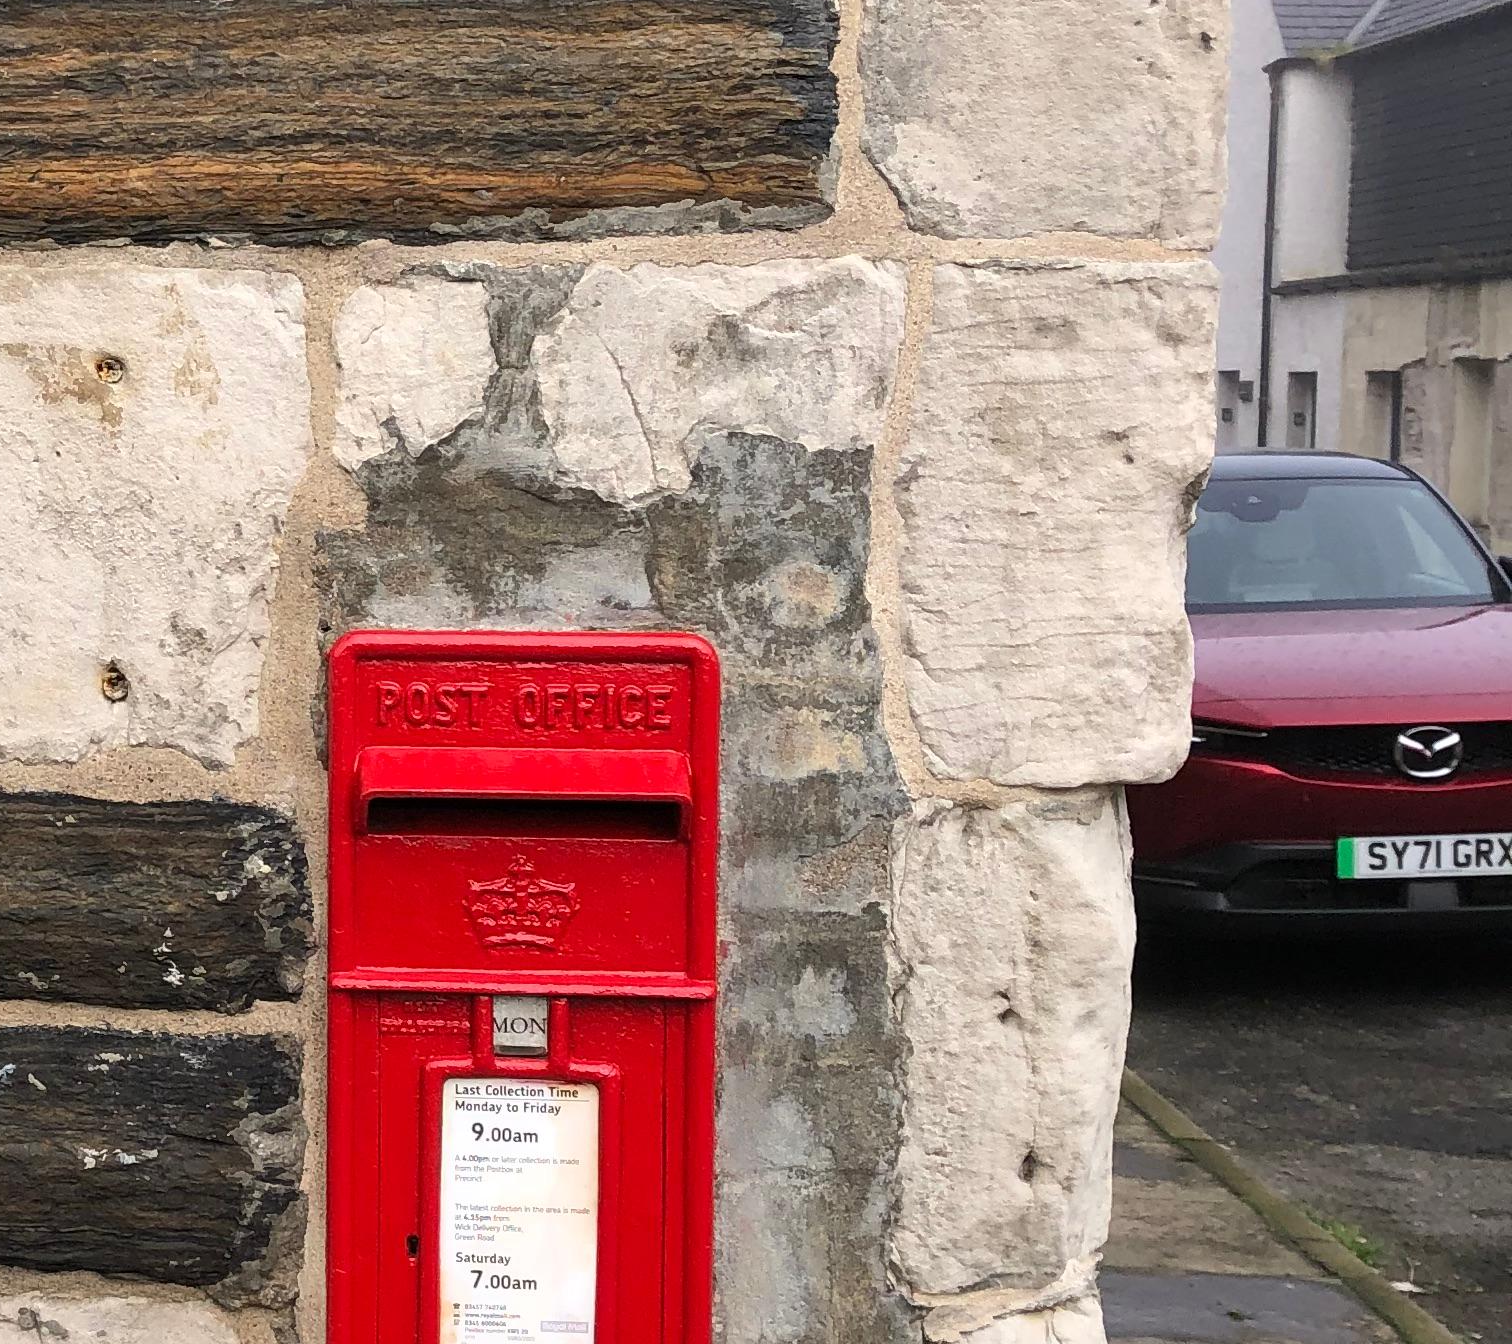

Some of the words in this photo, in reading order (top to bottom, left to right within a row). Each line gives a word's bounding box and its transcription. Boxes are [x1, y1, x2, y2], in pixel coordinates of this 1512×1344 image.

[376, 680, 495, 729] POST
[514, 683, 674, 731] OFFICE
[1368, 840, 1442, 871] SY71
[1452, 838, 1512, 869] GRX
[493, 1017, 547, 1034] MON
[455, 1084, 481, 1095] Last
[485, 1085, 544, 1097] Collection
[547, 1087, 579, 1098] Time
[455, 1100, 502, 1114] Monday
[507, 1102, 519, 1113] to
[524, 1102, 561, 1116] Friday
[471, 1122, 538, 1143] 9.00am
[454, 1164, 472, 1172] from
[518, 1156, 551, 1165] collection
[559, 1158, 580, 1166] made
[455, 1203, 468, 1211] The
[469, 1203, 489, 1212] latest
[491, 1204, 523, 1213] collection
[533, 1206, 544, 1214] the
[570, 1207, 590, 1215] made
[493, 1214, 510, 1222] from
[454, 1223, 471, 1231] Wick
[472, 1223, 501, 1233] Delivery
[454, 1233, 476, 1241] Green
[477, 1234, 495, 1242] Road
[455, 1251, 511, 1266] Saturday
[470, 1269, 538, 1291] 7.00am
